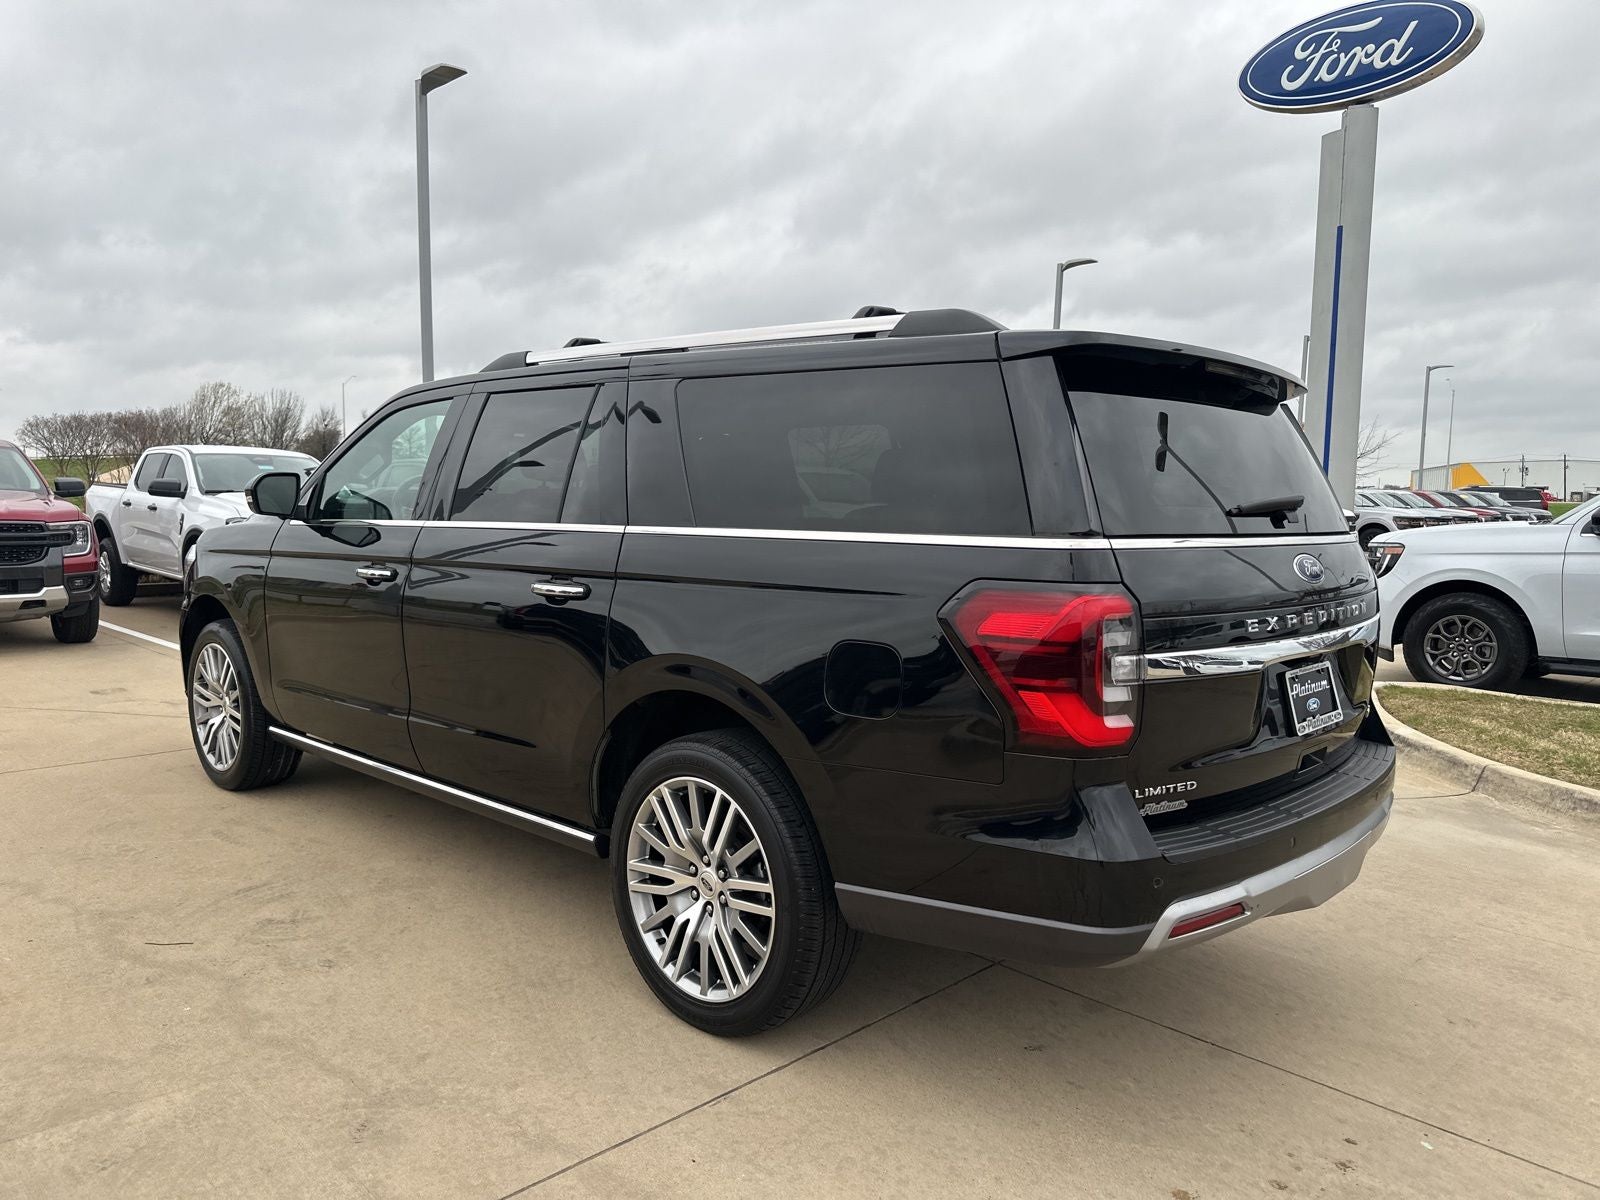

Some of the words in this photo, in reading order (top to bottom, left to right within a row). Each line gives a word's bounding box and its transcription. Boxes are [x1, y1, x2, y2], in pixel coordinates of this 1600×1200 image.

[1280, 16, 1419, 91] Ford
[1246, 602, 1367, 633] EXPEDITION
[1291, 680, 1330, 698] Platinum
[1134, 780, 1198, 799] LIMITED
[1139, 800, 1188, 816] Platinum
